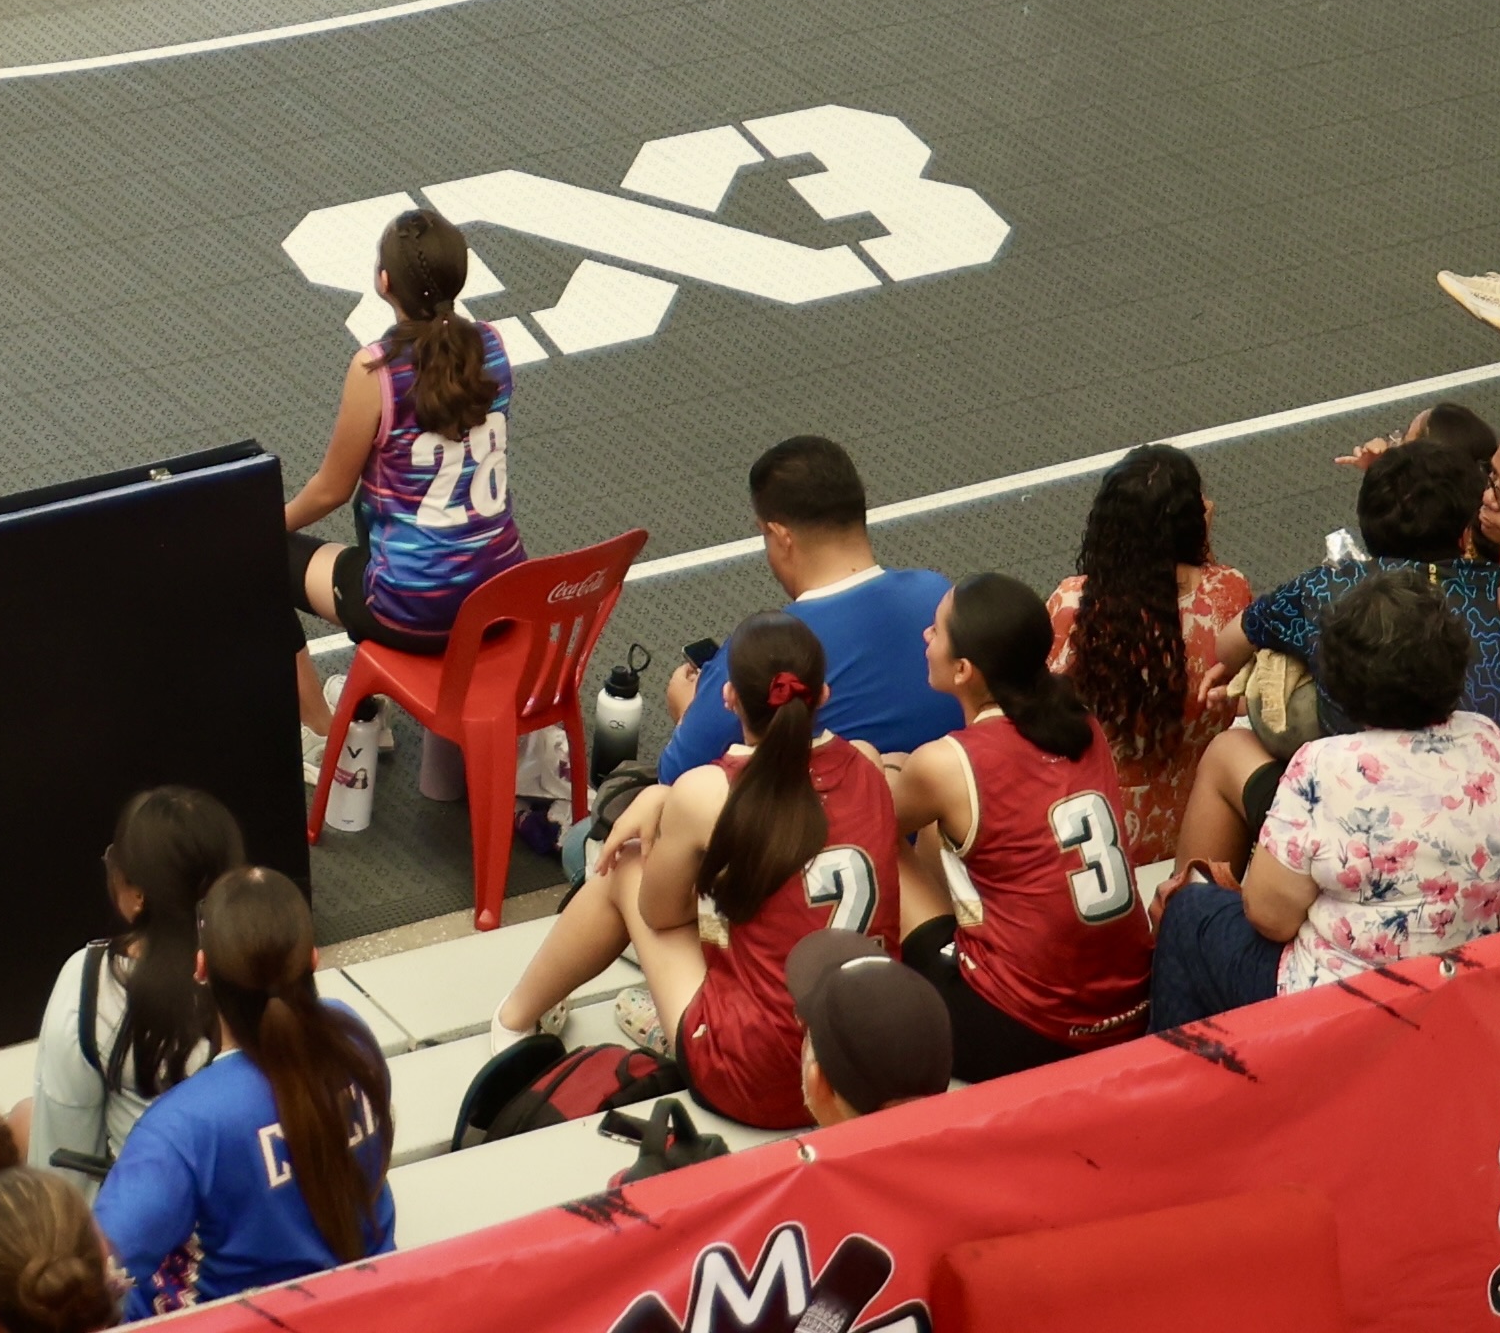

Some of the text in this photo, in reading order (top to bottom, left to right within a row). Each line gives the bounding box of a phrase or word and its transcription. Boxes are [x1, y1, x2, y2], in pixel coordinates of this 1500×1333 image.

[409, 410, 509, 531] 28
[545, 567, 609, 604] Coca-Cola
[1049, 788, 1135, 925] 3
